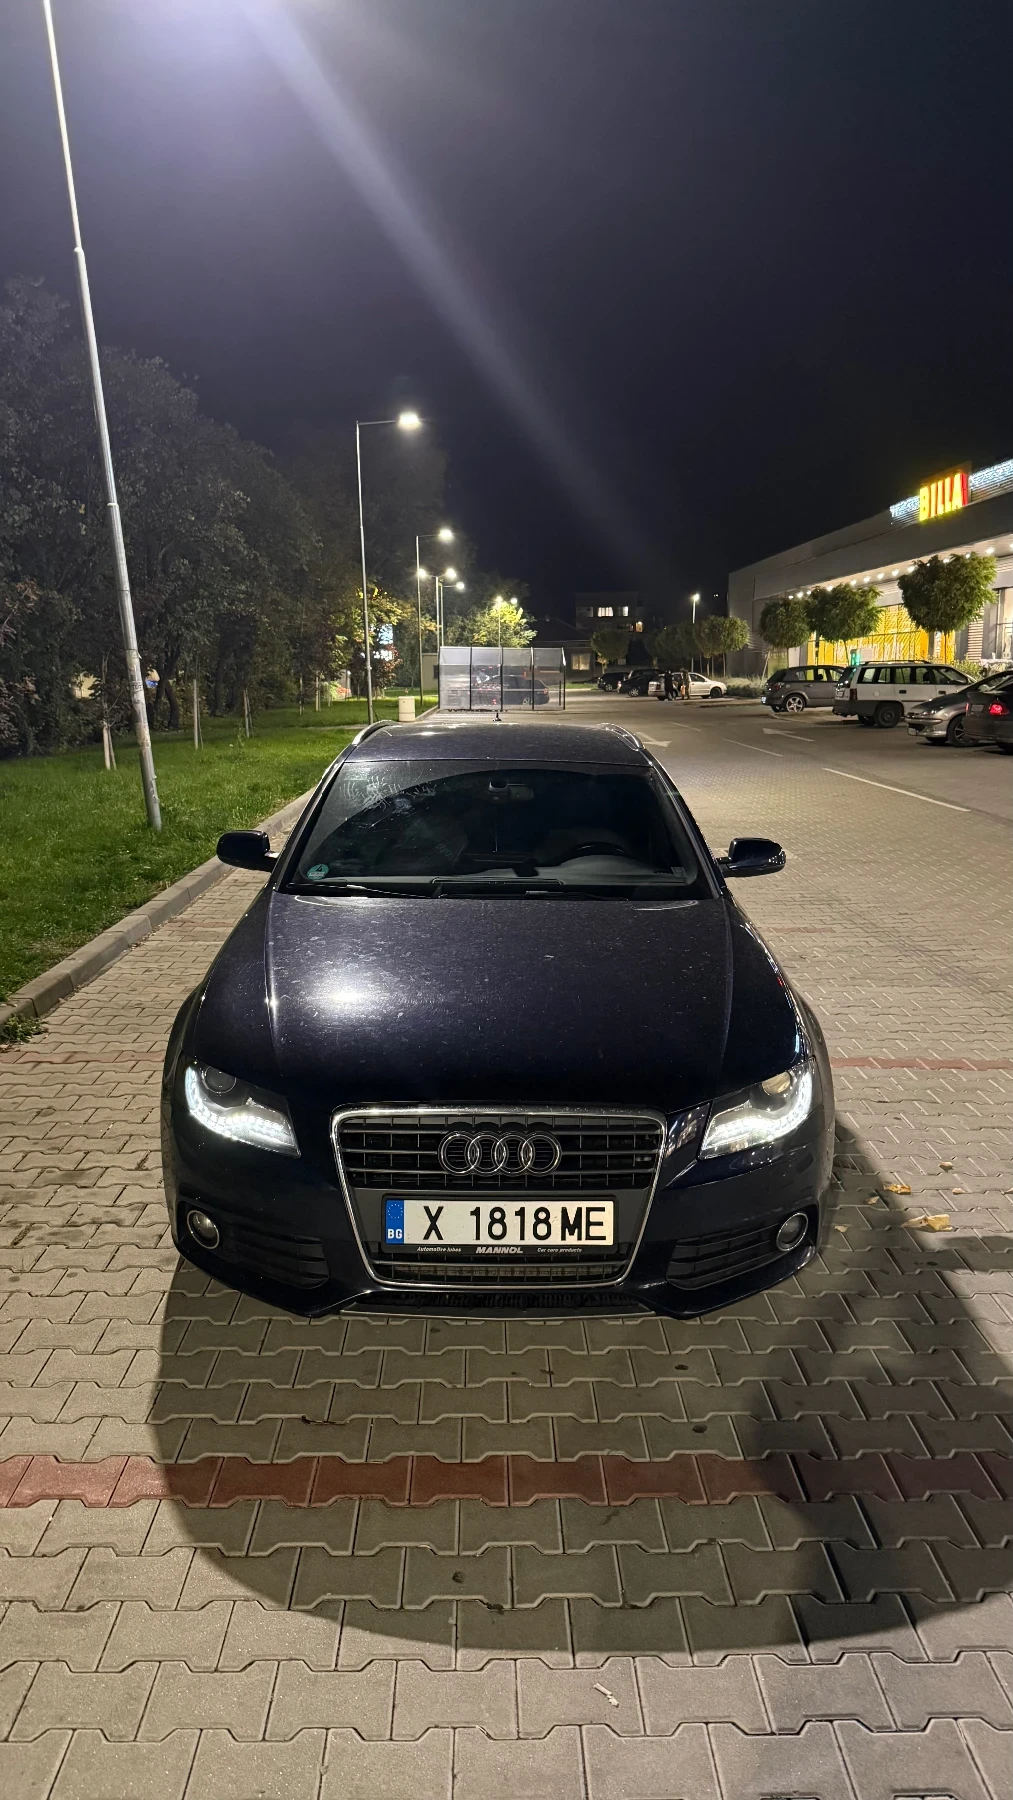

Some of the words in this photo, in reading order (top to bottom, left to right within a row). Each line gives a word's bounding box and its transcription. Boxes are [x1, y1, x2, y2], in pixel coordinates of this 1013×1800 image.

[919, 472, 968, 521] BILLA
[387, 1228, 403, 1239] BG
[423, 1205, 444, 1240] X
[469, 1206, 552, 1240] 1818
[560, 1206, 607, 1241] ME
[475, 1246, 524, 1254] MANNOL
